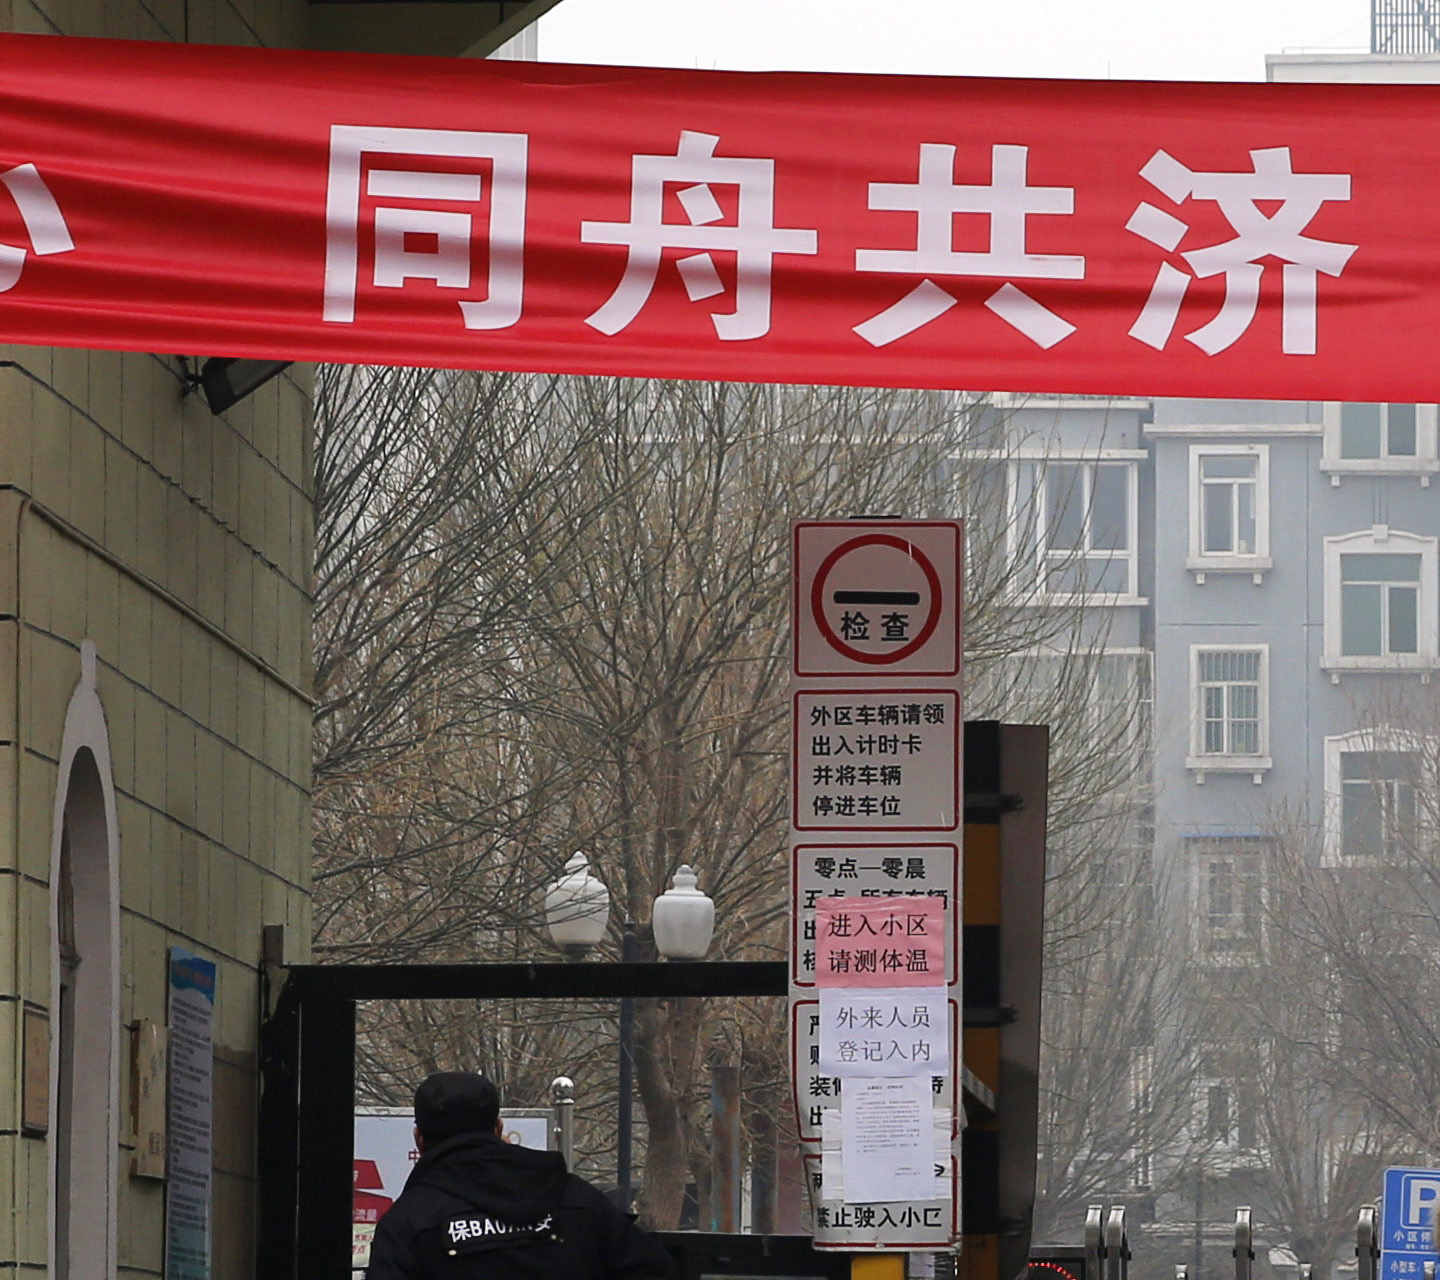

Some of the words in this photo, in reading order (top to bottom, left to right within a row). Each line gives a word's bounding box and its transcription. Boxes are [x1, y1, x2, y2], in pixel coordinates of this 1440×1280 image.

[322, 124, 1361, 357] 同舟共济
[840, 610, 910, 642] 检查
[810, 703, 946, 728] 外区车辆请领
[811, 734, 923, 757] 出入计时卡
[812, 765, 903, 787] 并将车辆
[812, 795, 902, 818] 停进车位
[827, 913, 929, 937] 进入小区
[827, 948, 930, 974] 请测体温
[835, 1006, 931, 1029] 外来人员
[835, 1040, 931, 1063] 登记入内
